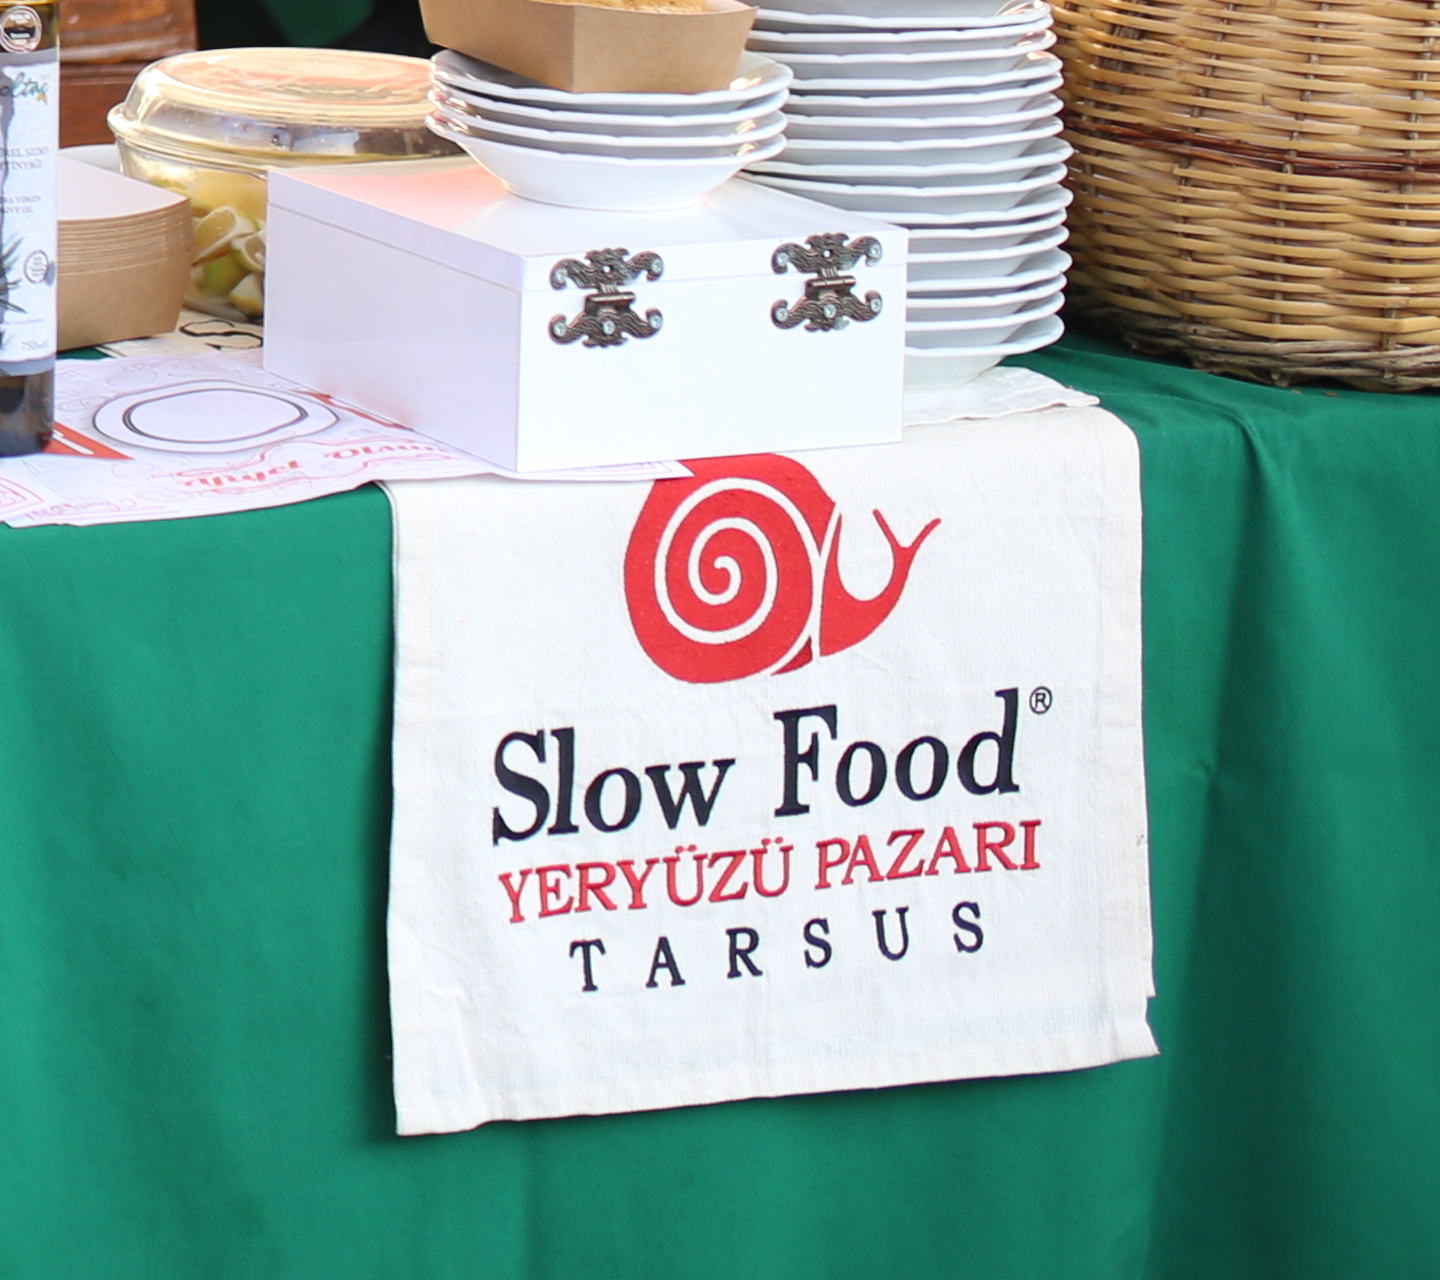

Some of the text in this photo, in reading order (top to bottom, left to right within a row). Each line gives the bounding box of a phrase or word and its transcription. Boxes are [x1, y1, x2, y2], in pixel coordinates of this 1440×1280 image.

[492, 727, 736, 845] Slow
[498, 819, 1042, 924] YERYÜZÜ PAZARI
[569, 901, 986, 993] TARSUS
